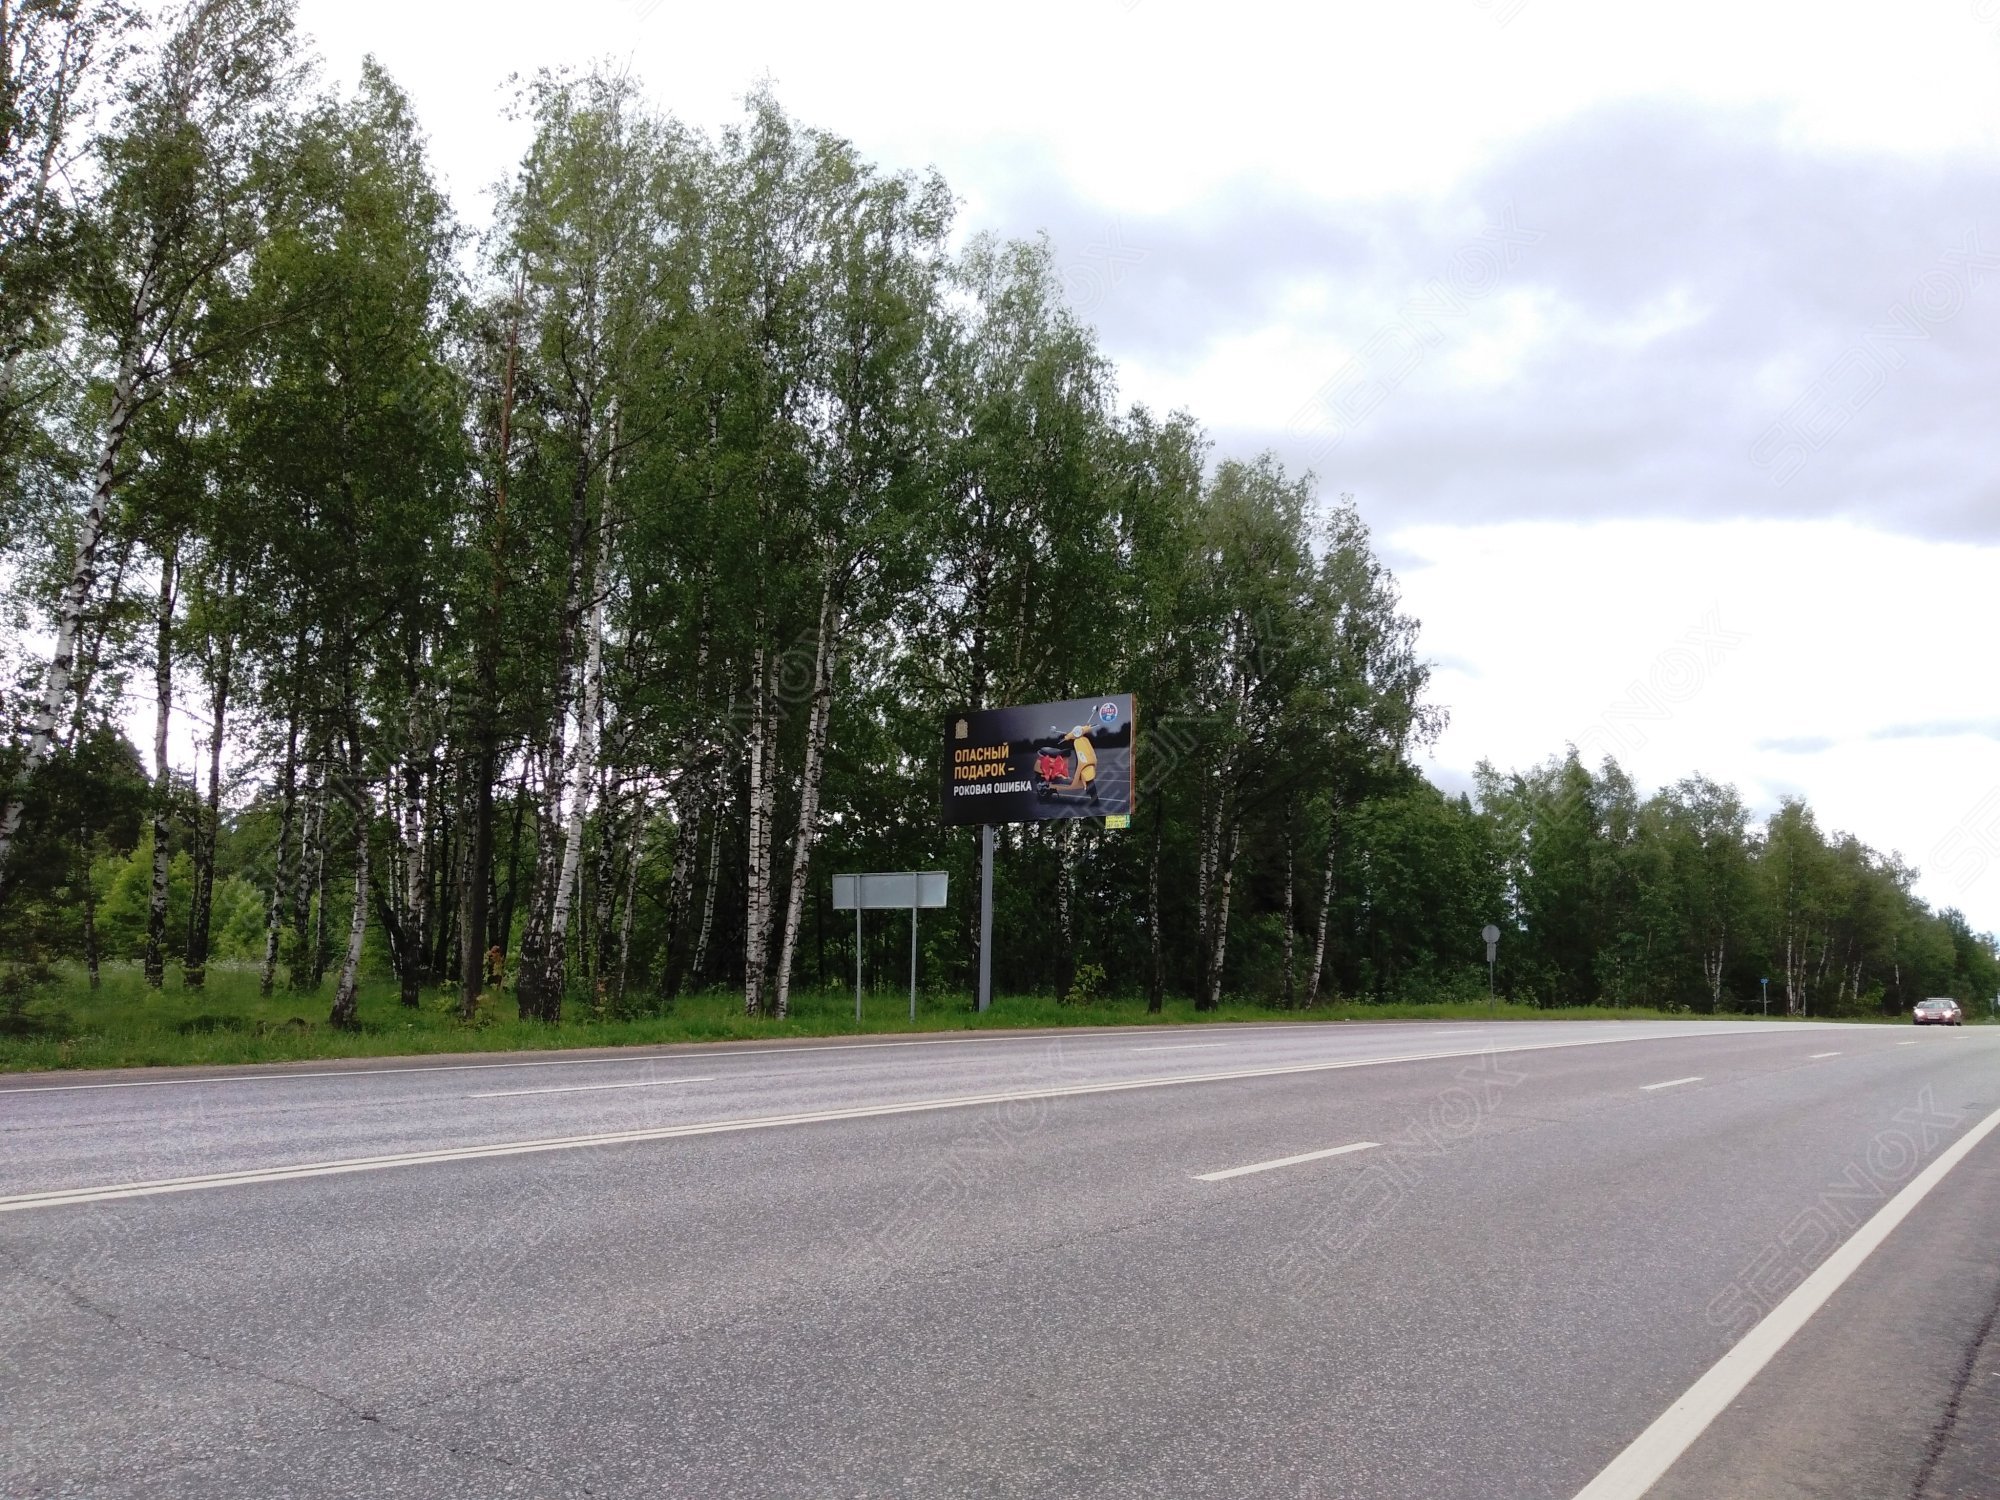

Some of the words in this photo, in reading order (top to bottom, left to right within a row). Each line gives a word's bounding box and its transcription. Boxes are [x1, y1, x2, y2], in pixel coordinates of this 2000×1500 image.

[955, 743, 1009, 763] ОПАСНЫЙ
[954, 763, 1005, 780] ПОДАРОК
[953, 783, 992, 796] РОКОВАЯ
[994, 780, 1032, 793] ОШИБКА
